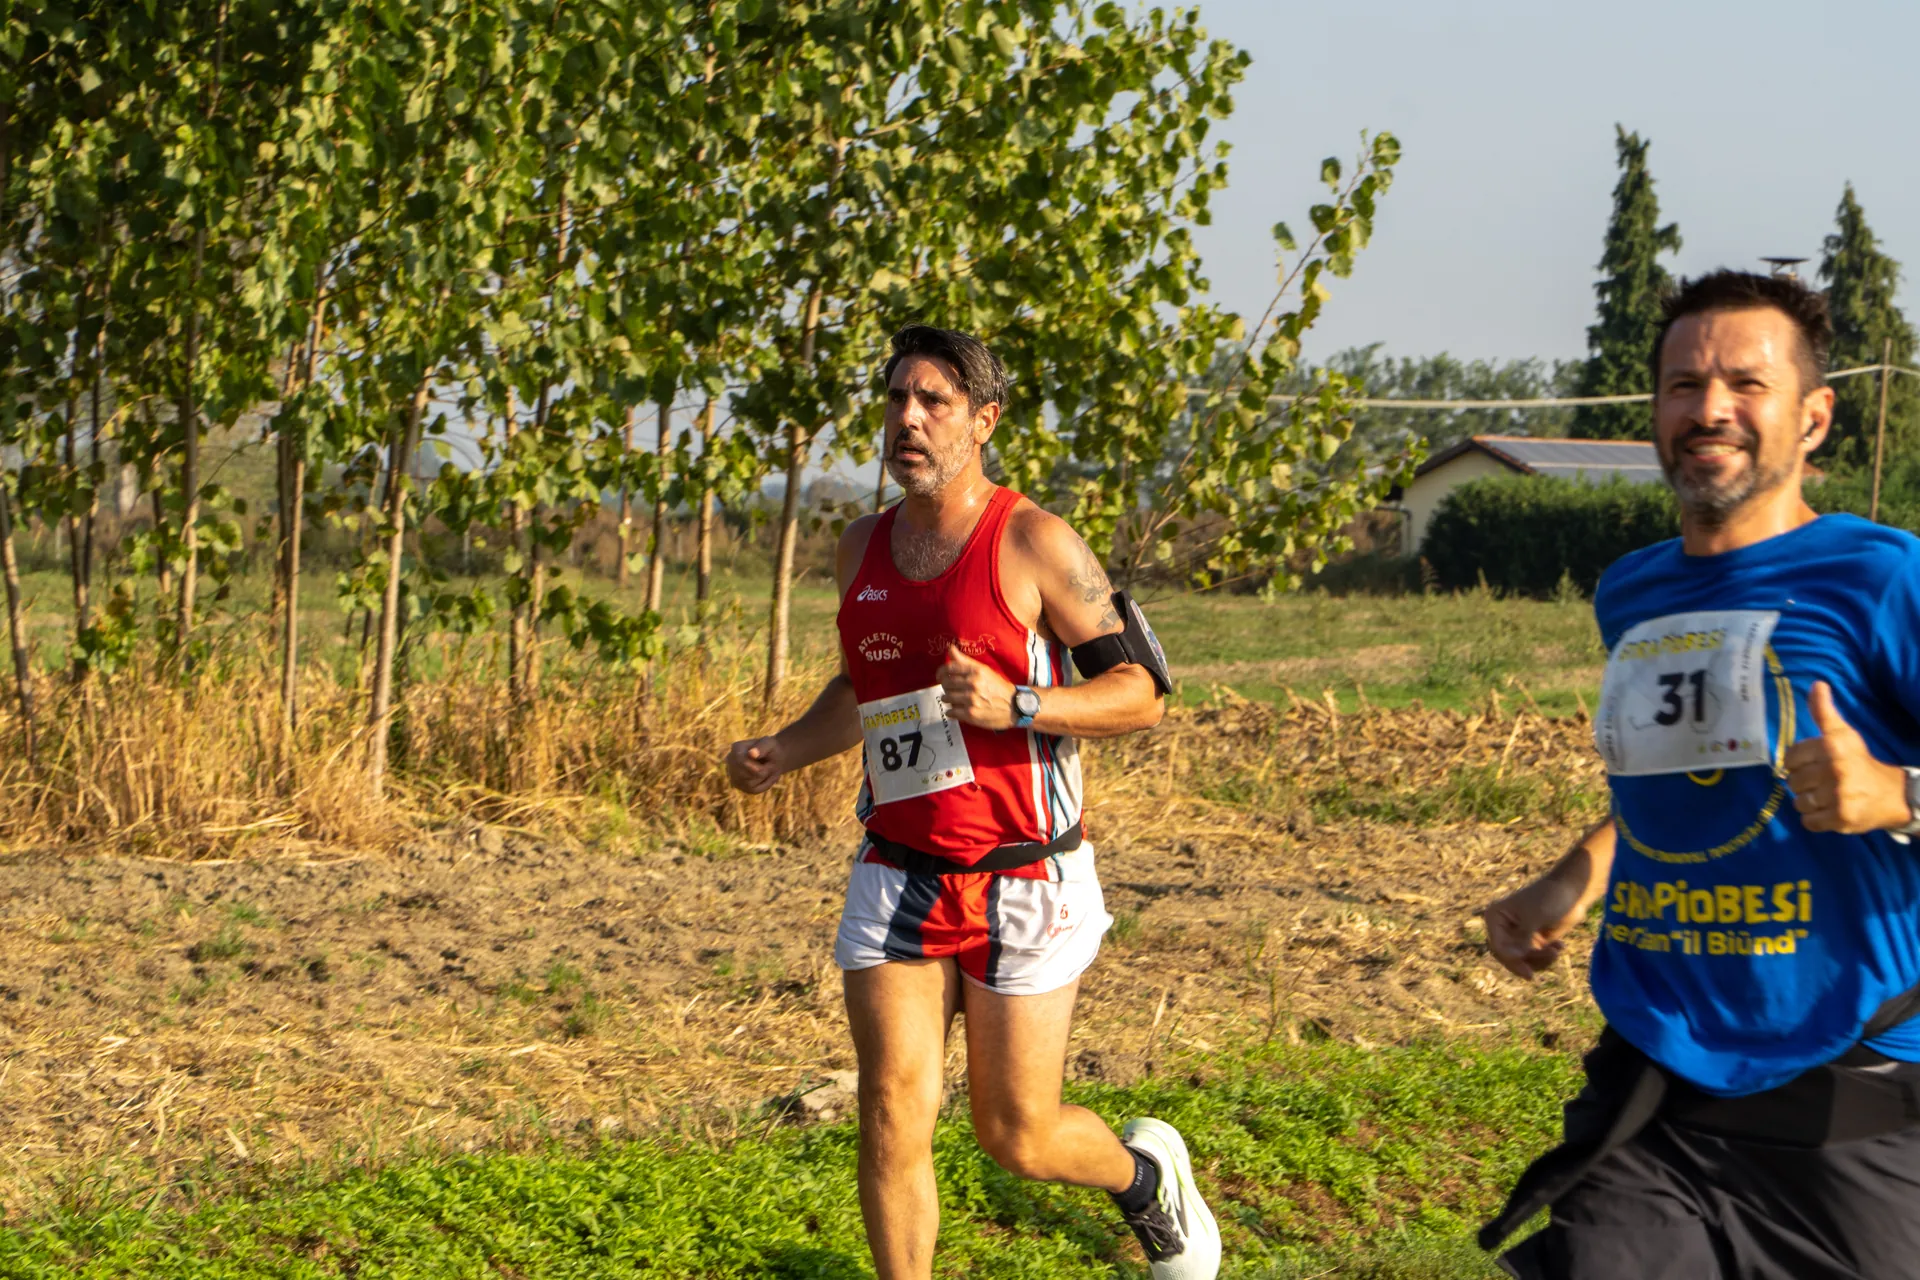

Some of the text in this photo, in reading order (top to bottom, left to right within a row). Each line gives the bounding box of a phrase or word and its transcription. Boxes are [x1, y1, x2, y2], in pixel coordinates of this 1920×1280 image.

[860, 586, 888, 602] asics
[858, 632, 904, 654] ATLETICA
[865, 648, 901, 662] SUSA
[1653, 668, 1707, 727] 31
[880, 730, 923, 772] 87
